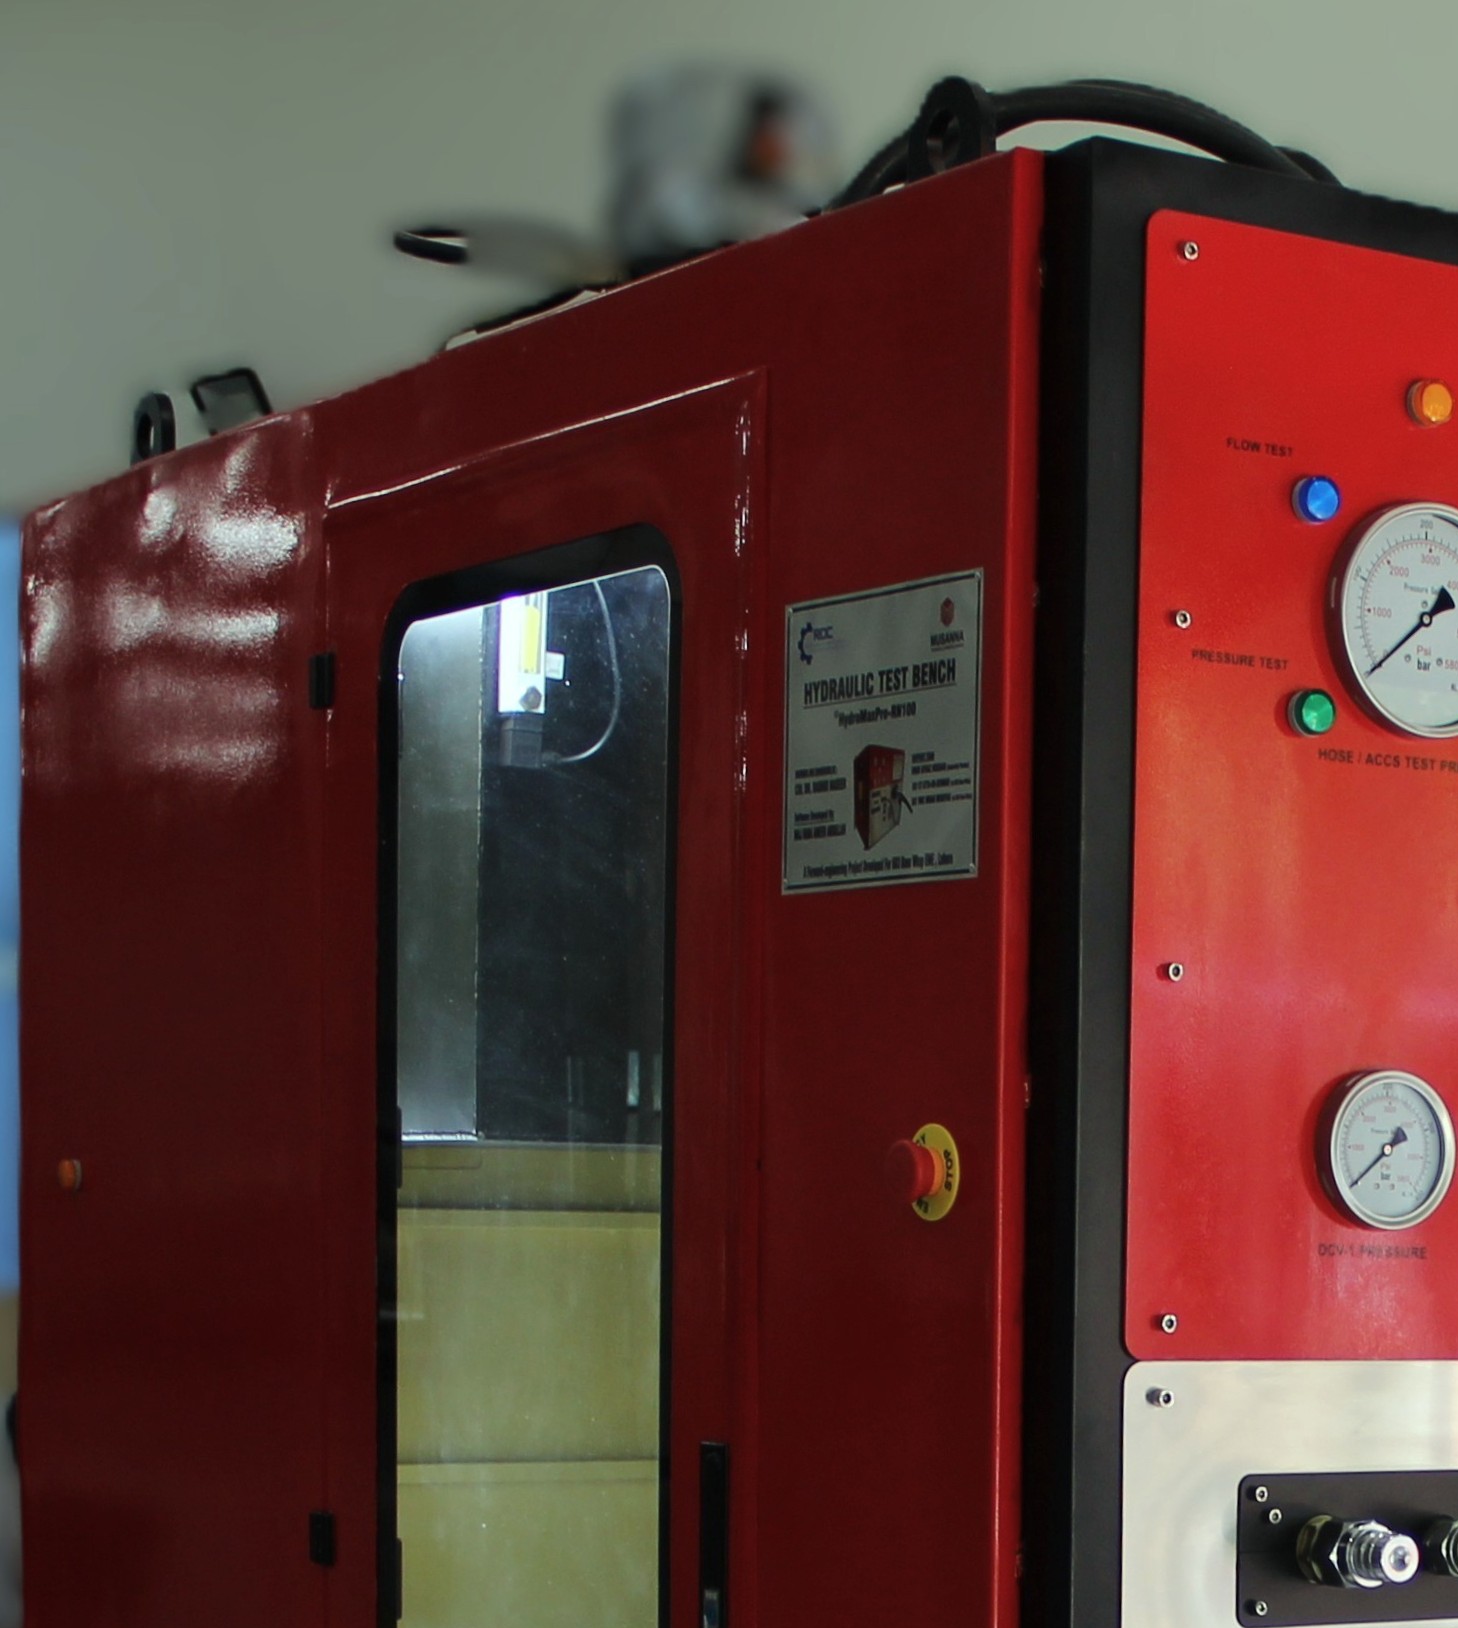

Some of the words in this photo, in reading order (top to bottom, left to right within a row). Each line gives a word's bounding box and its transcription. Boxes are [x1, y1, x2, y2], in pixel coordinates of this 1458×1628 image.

[1226, 437, 1261, 453] FLOW
[1264, 442, 1294, 457] TEST
[1421, 554, 1440, 566] 3000
[1389, 566, 1409, 577] 2000
[1372, 608, 1392, 618] 1000
[1417, 645, 1431, 656] Psi
[1192, 648, 1256, 667] PRESSURE
[1258, 655, 1289, 670] TEST
[1417, 658, 1430, 671] bar
[804, 672, 874, 705] HYDRAULIC
[879, 666, 908, 693] TEST
[913, 658, 956, 687] BENCH
[1318, 749, 1354, 764] HOSE
[1365, 753, 1401, 768] ACCS
[1404, 757, 1436, 772] TEST
